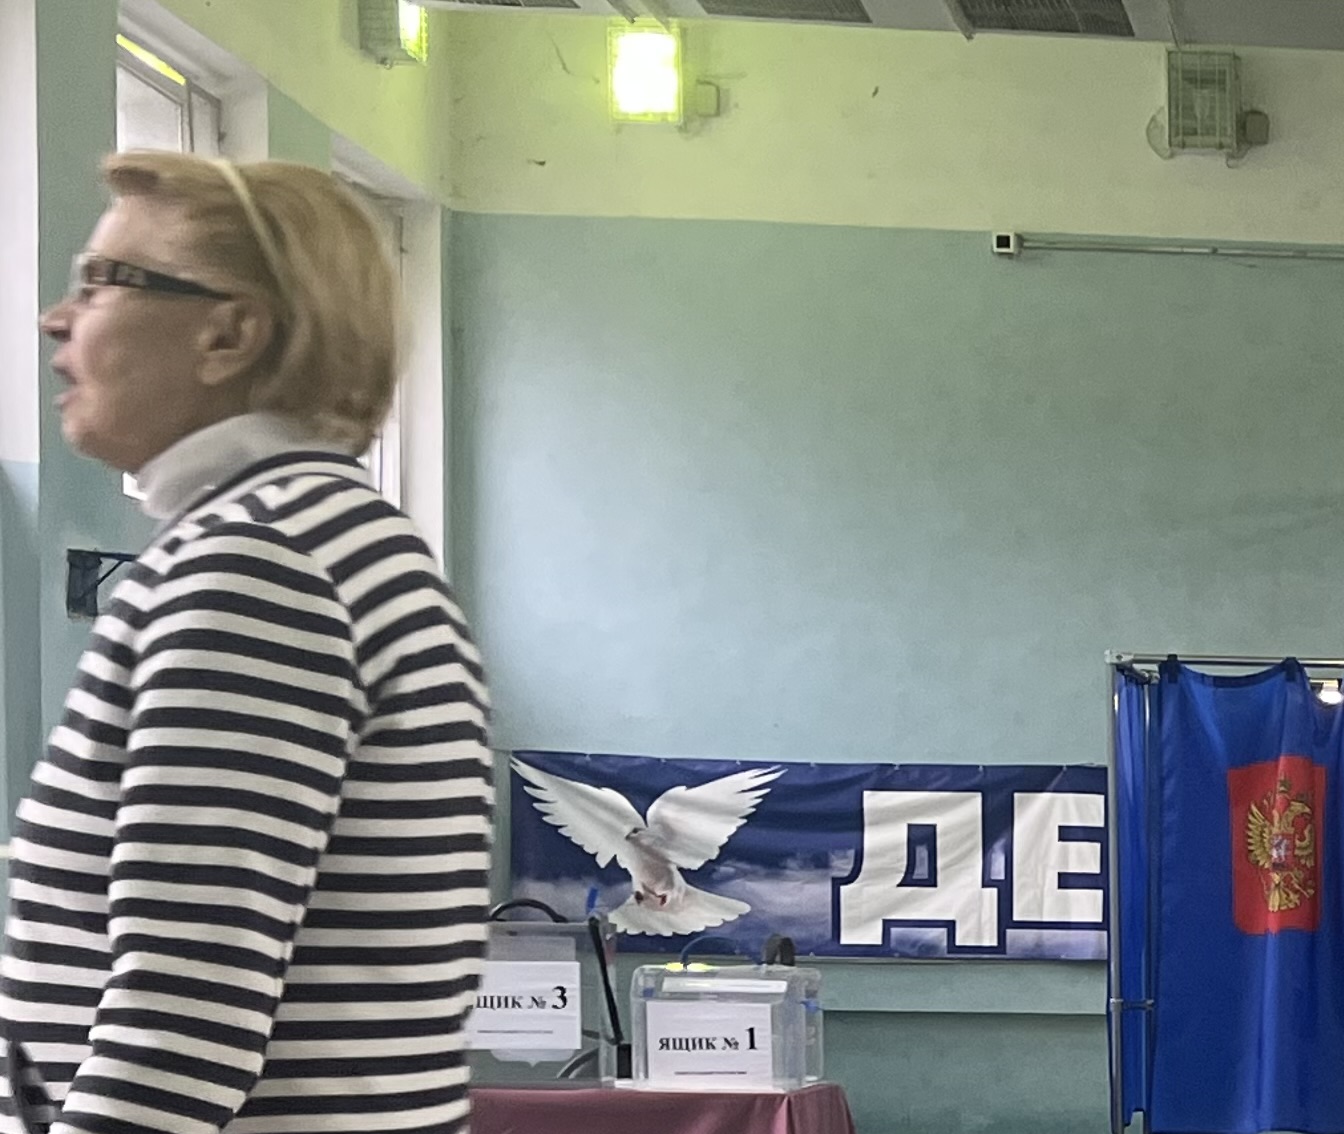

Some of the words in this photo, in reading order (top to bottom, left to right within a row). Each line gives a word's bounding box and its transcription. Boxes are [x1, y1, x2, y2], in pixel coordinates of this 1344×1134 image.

[475, 995, 523, 1011] ЩИК
[527, 995, 547, 1010] №
[551, 985, 568, 1010] 3
[658, 1036, 717, 1053] ЯЩИК
[721, 1036, 740, 1051] №
[745, 1026, 758, 1051] 1
